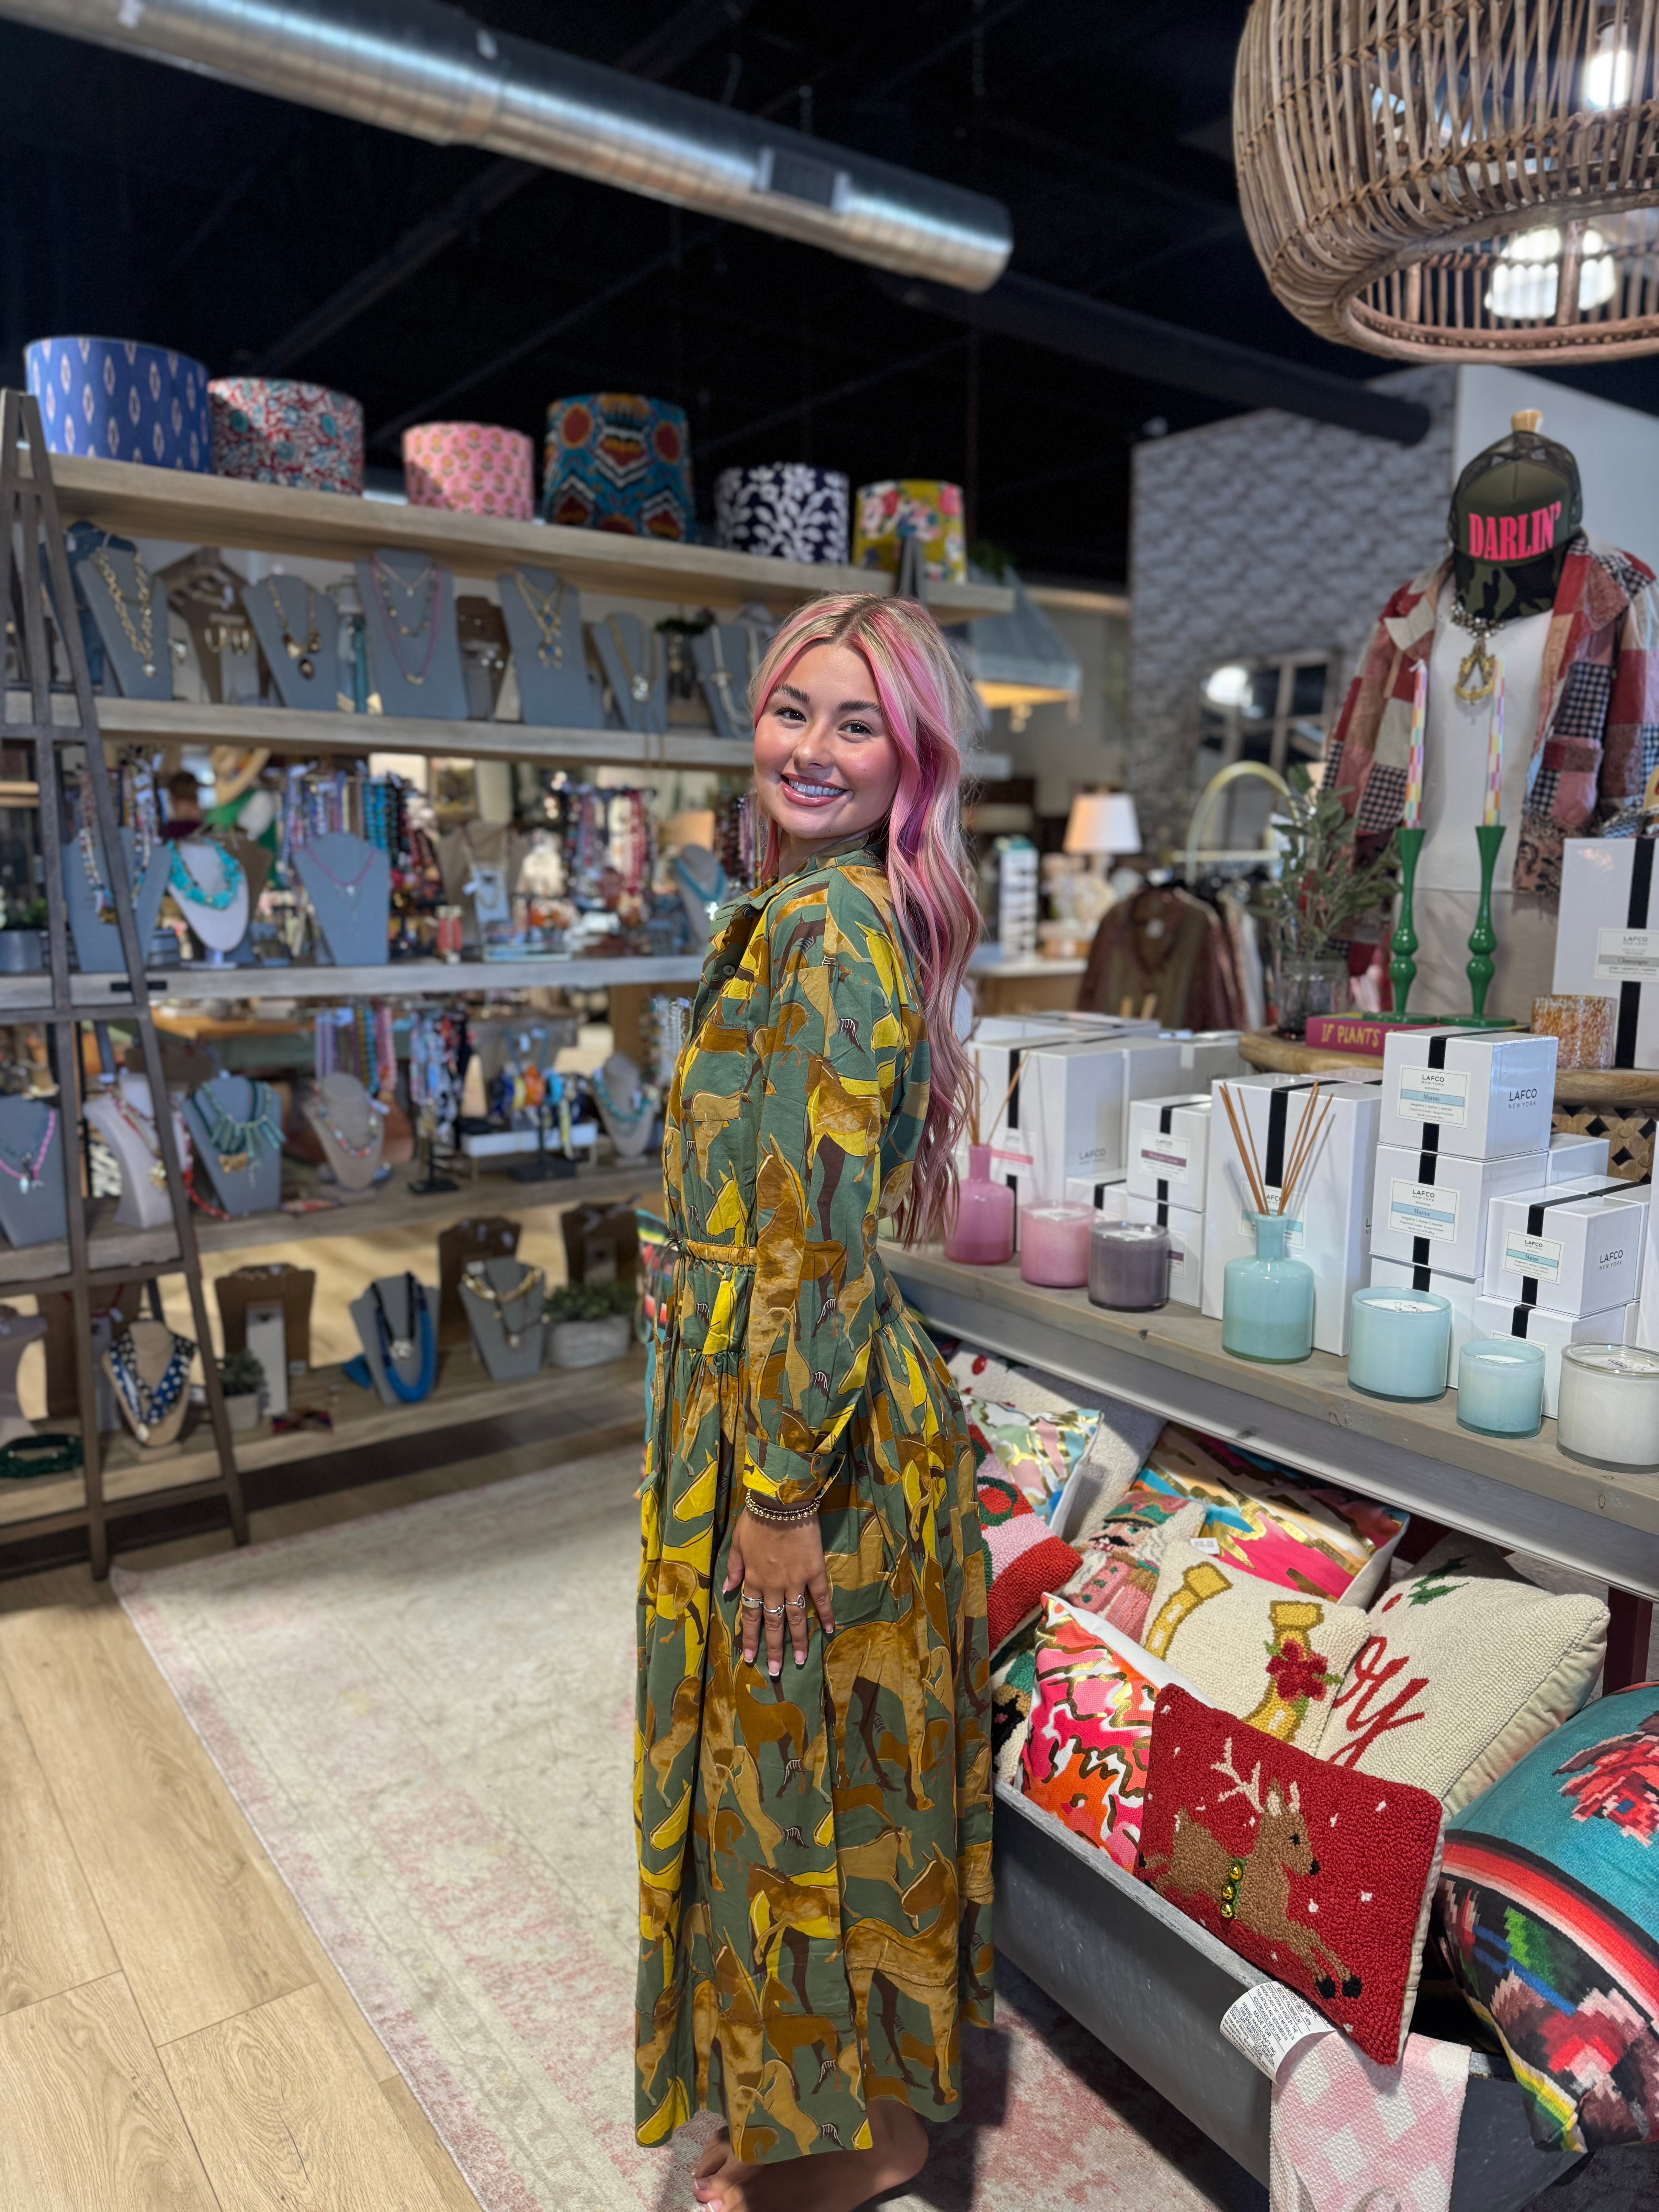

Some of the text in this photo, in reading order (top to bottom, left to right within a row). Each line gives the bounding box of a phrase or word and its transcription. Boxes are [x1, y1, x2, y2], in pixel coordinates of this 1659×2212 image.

[1618, 957, 1649, 965] Champagne
[1321, 1023, 1381, 1048] IF PLANTS
[1509, 1089, 1537, 1101] LAFCO
[1079, 1148, 1106, 1160] LAFCO
[1413, 1189, 1435, 1198] LAFCO
[1414, 1208, 1431, 1216] Marine
[1600, 1250, 1623, 1263] LAFCO
[1252, 1996, 1270, 2022] ACCORDANCE
[1267, 2020, 1276, 2032] WITH
[1260, 1985, 1275, 2007] MANUFACTURER
[1280, 2019, 1293, 2037] MATERIALS
[1265, 1983, 1282, 2007] CERTIFICATION
[1281, 2009, 1290, 2021] MADE
[1295, 2001, 1305, 2013] FIBER
[1304, 2015, 1312, 2026] 100%
[1305, 2008, 1312, 2016] OF
[1232, 2004, 1242, 2017] SOUTH
[1244, 2023, 1259, 2043] FRANCISCO
[1241, 2002, 1253, 2019] PEKING
[1251, 2018, 1271, 2046] HANDICRAFT
[1244, 2016, 1252, 2026] SAN
[1250, 2025, 1262, 2041] MATEO
[1252, 2010, 1264, 2026] MADE
[1261, 2025, 1272, 2038] FOR
[1259, 1996, 1270, 2010] ARTICLE
[1271, 2016, 1286, 2037] DESCRIBED
[1238, 2024, 1250, 2039] delivery
